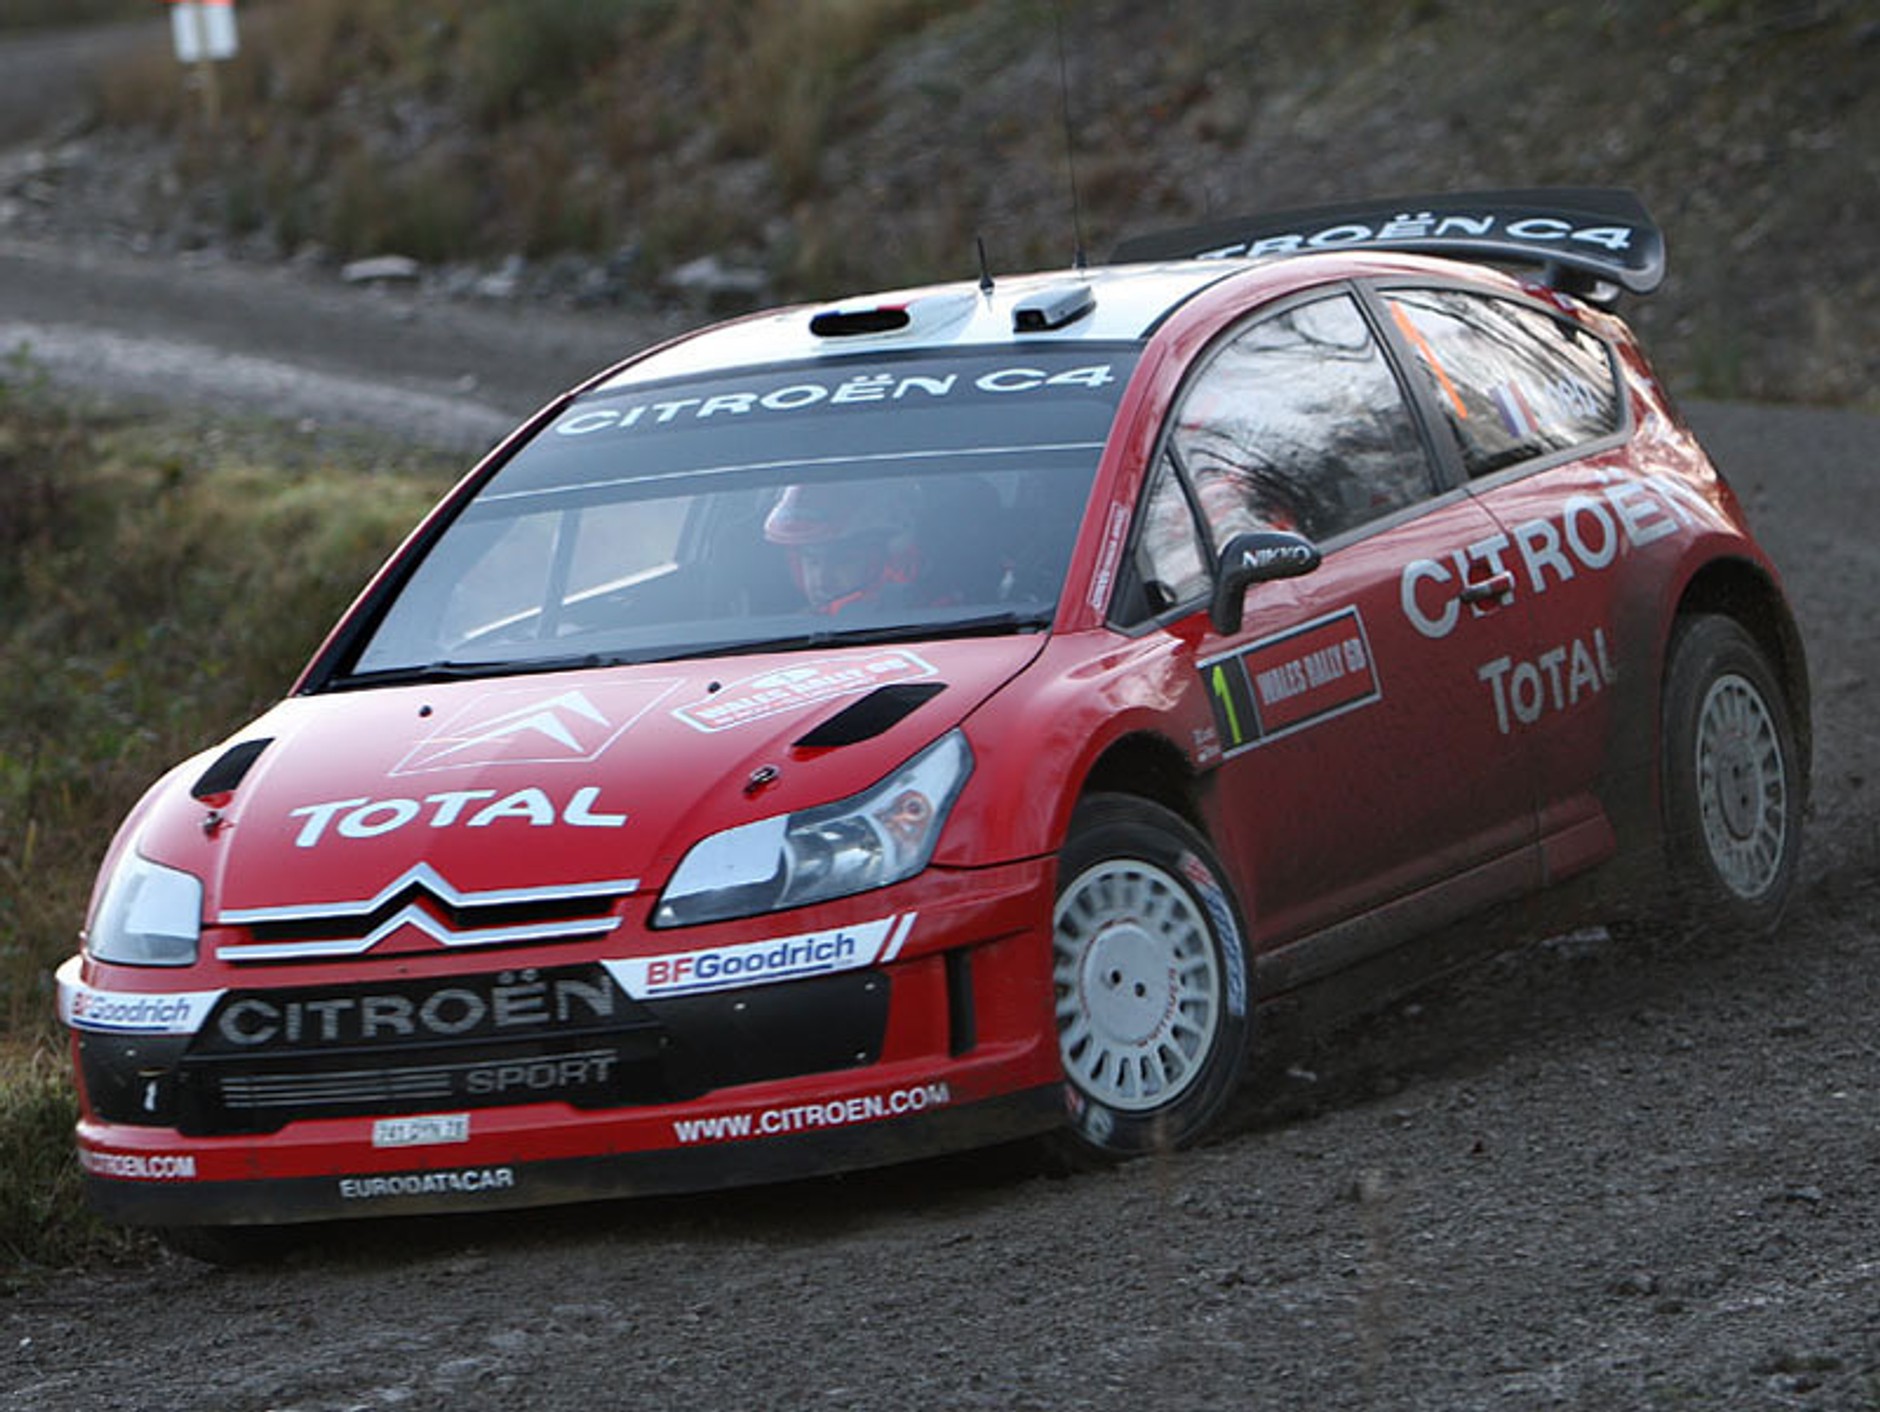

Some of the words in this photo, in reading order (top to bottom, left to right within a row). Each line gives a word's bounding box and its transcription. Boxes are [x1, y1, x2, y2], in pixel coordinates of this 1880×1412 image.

[1506, 218, 1631, 249] C4
[555, 373, 958, 435] CITROËN
[974, 364, 1114, 393] C4
[1256, 660, 1308, 705] WALES
[1303, 644, 1345, 688] RALLY
[1478, 628, 1616, 734] TOTAL
[1212, 667, 1242, 744] 1
[289, 787, 628, 847] TOTAL
[645, 933, 856, 985] BFGoodrich
[217, 969, 615, 1046] CITROËN
[466, 1056, 618, 1095] SPORT
[673, 1083, 949, 1143] WWW.CITROEN.COM
